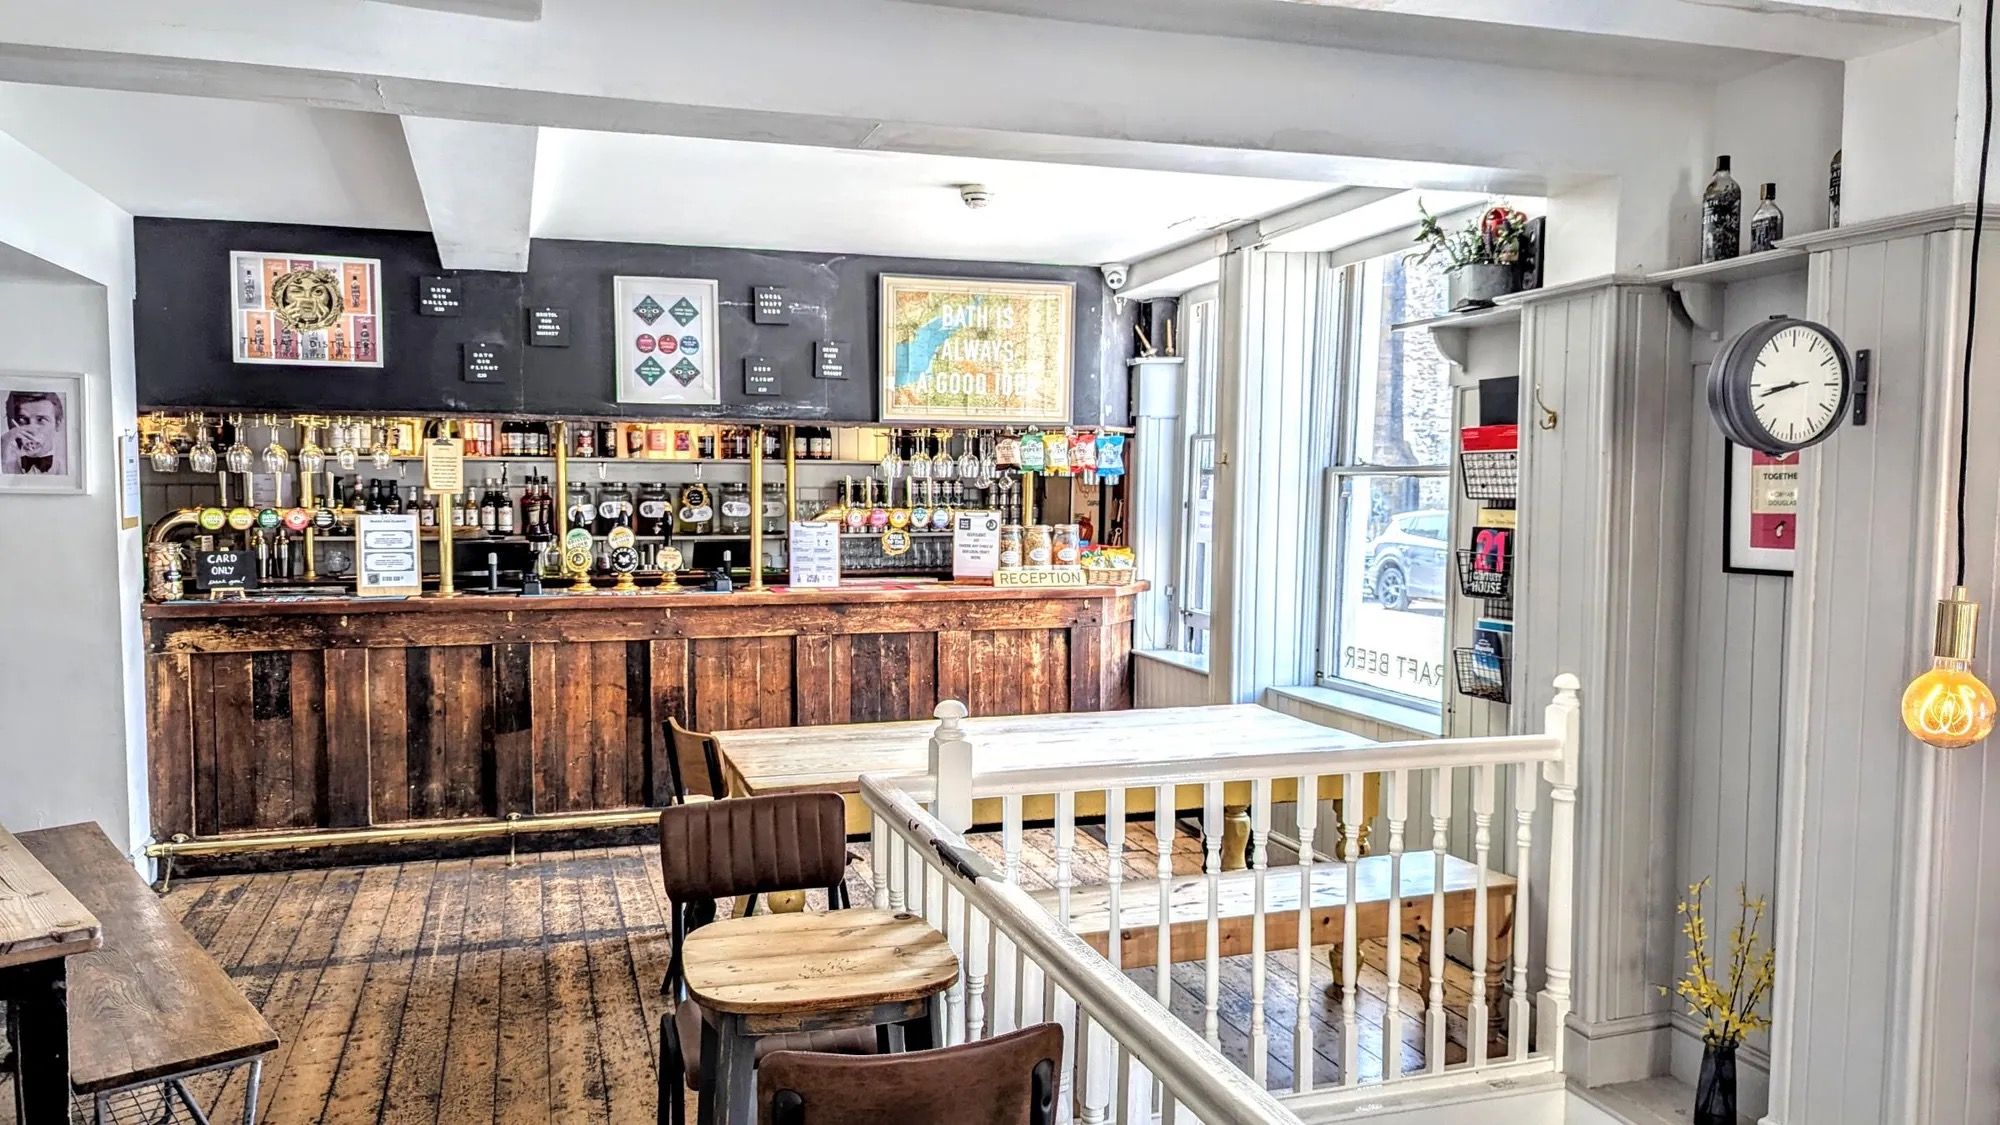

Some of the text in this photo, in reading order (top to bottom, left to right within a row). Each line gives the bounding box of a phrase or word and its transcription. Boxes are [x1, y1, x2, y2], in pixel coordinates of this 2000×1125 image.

[942, 303, 1015, 329] BATH IS
[240, 336, 265, 345] THE
[273, 338, 303, 347] BATH
[941, 338, 1015, 362] ALWAYS
[916, 372, 929, 393] A
[936, 371, 988, 395] GOOD
[1763, 472, 1798, 480] TOGETHE
[206, 553, 238, 564] CARD
[211, 566, 235, 575] ONLY
[1000, 572, 1082, 585] RECEPTION
[1471, 582, 1502, 594] HOUSE
